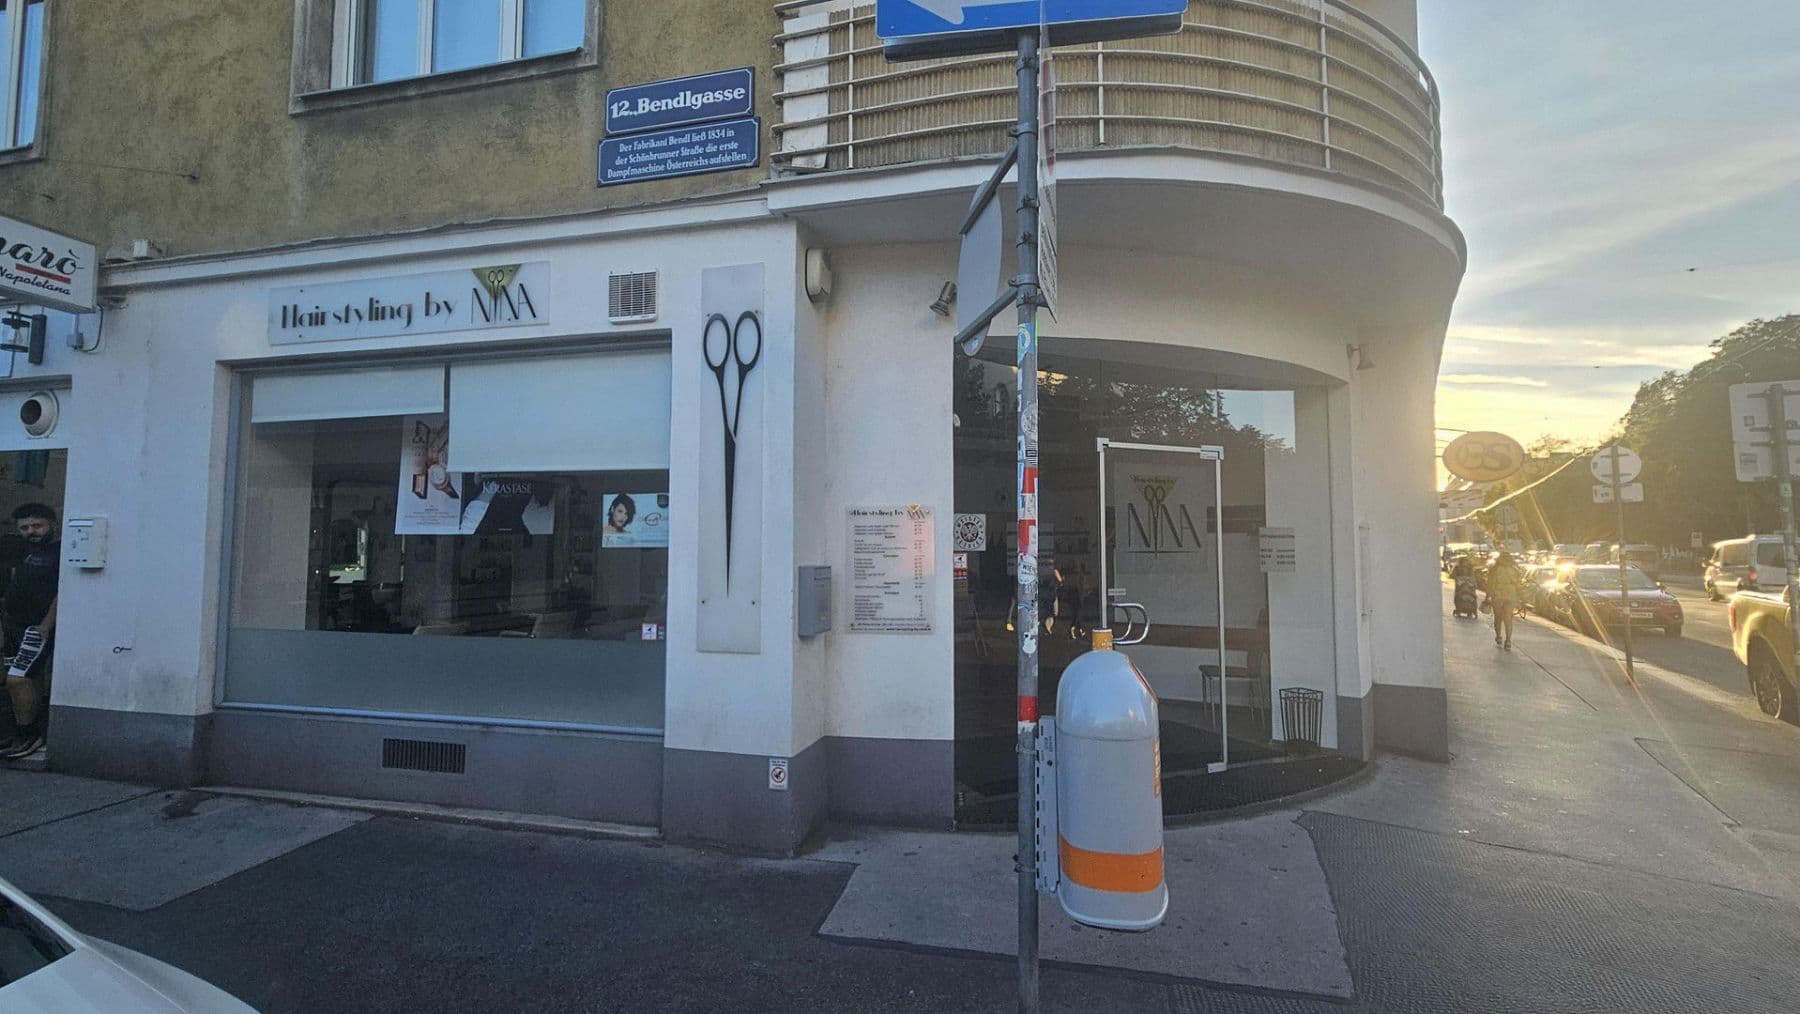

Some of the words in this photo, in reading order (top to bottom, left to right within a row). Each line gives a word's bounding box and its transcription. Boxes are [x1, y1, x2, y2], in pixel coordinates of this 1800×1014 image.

[637, 87, 746, 114] Bendlgasse
[615, 155, 628, 166] der
[628, 149, 680, 164] Schönbrunner
[681, 145, 704, 157] Straße
[705, 143, 718, 153] die
[719, 141, 739, 151] erste
[619, 143, 632, 153] Der
[633, 138, 668, 151] Fabrikant
[669, 134, 690, 146] Bendl
[691, 131, 706, 143] ließ
[708, 129, 725, 140] 1834
[726, 128, 735, 138] in
[607, 163, 666, 179] Dampfmaschine
[666, 157, 709, 171] Österreichs
[709, 151, 747, 164] aufstellen
[281, 296, 413, 332] Hairstyling
[424, 291, 457, 326] by
[471, 283, 537, 325] NINA
[1127, 502, 1201, 549] NINA
